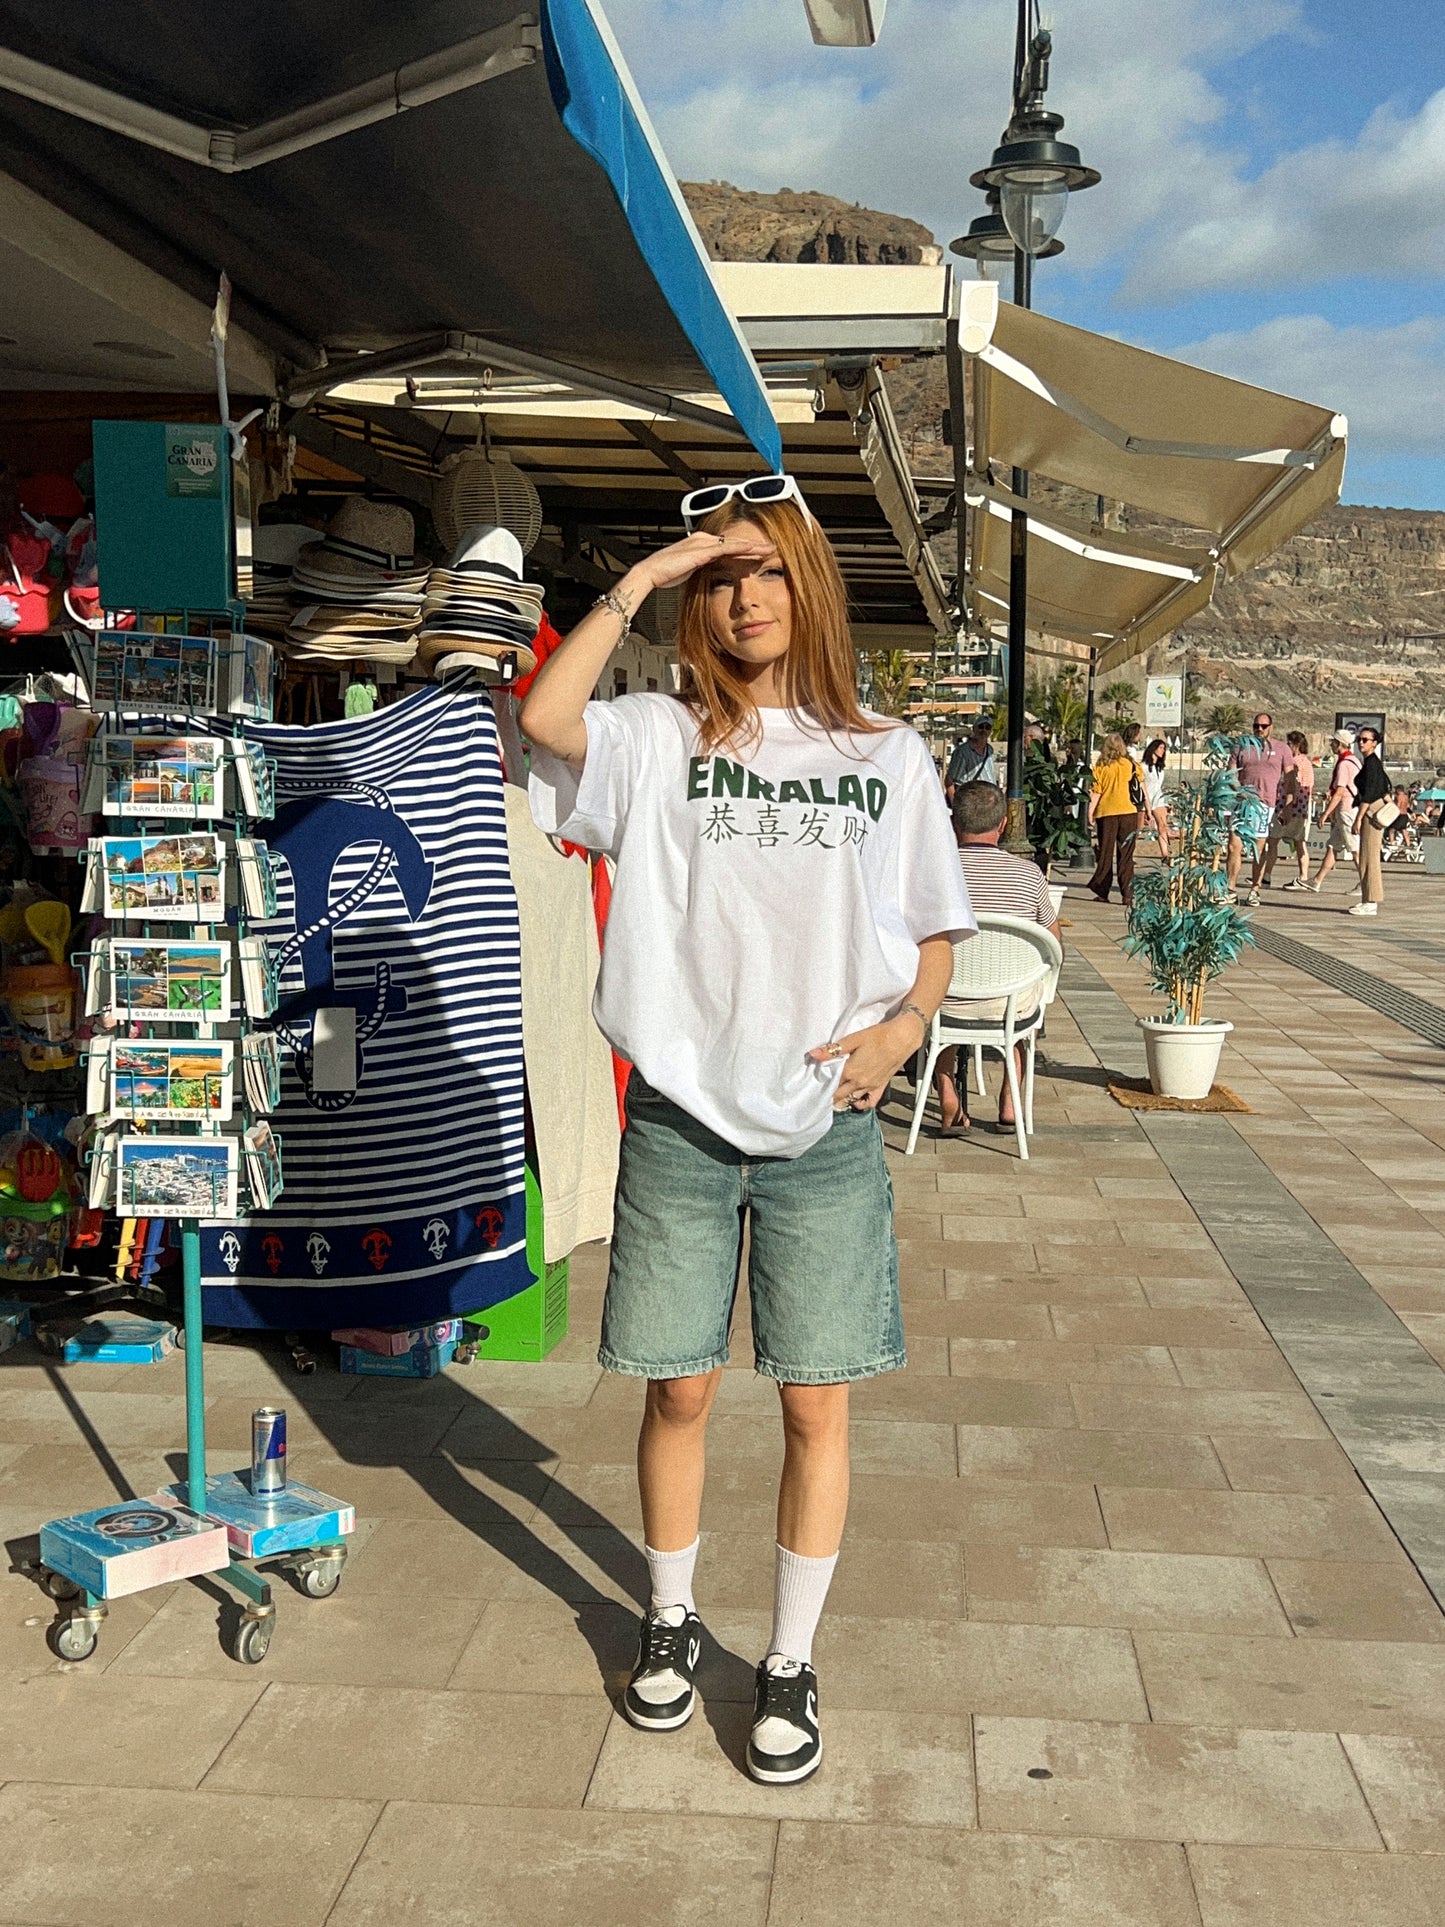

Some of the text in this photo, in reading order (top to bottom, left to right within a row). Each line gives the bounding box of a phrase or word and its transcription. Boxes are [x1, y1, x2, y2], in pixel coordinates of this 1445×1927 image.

[172, 444, 202, 455] GRAN
[168, 455, 213, 466] CANARIA
[699, 802, 869, 856] 恭喜发财
